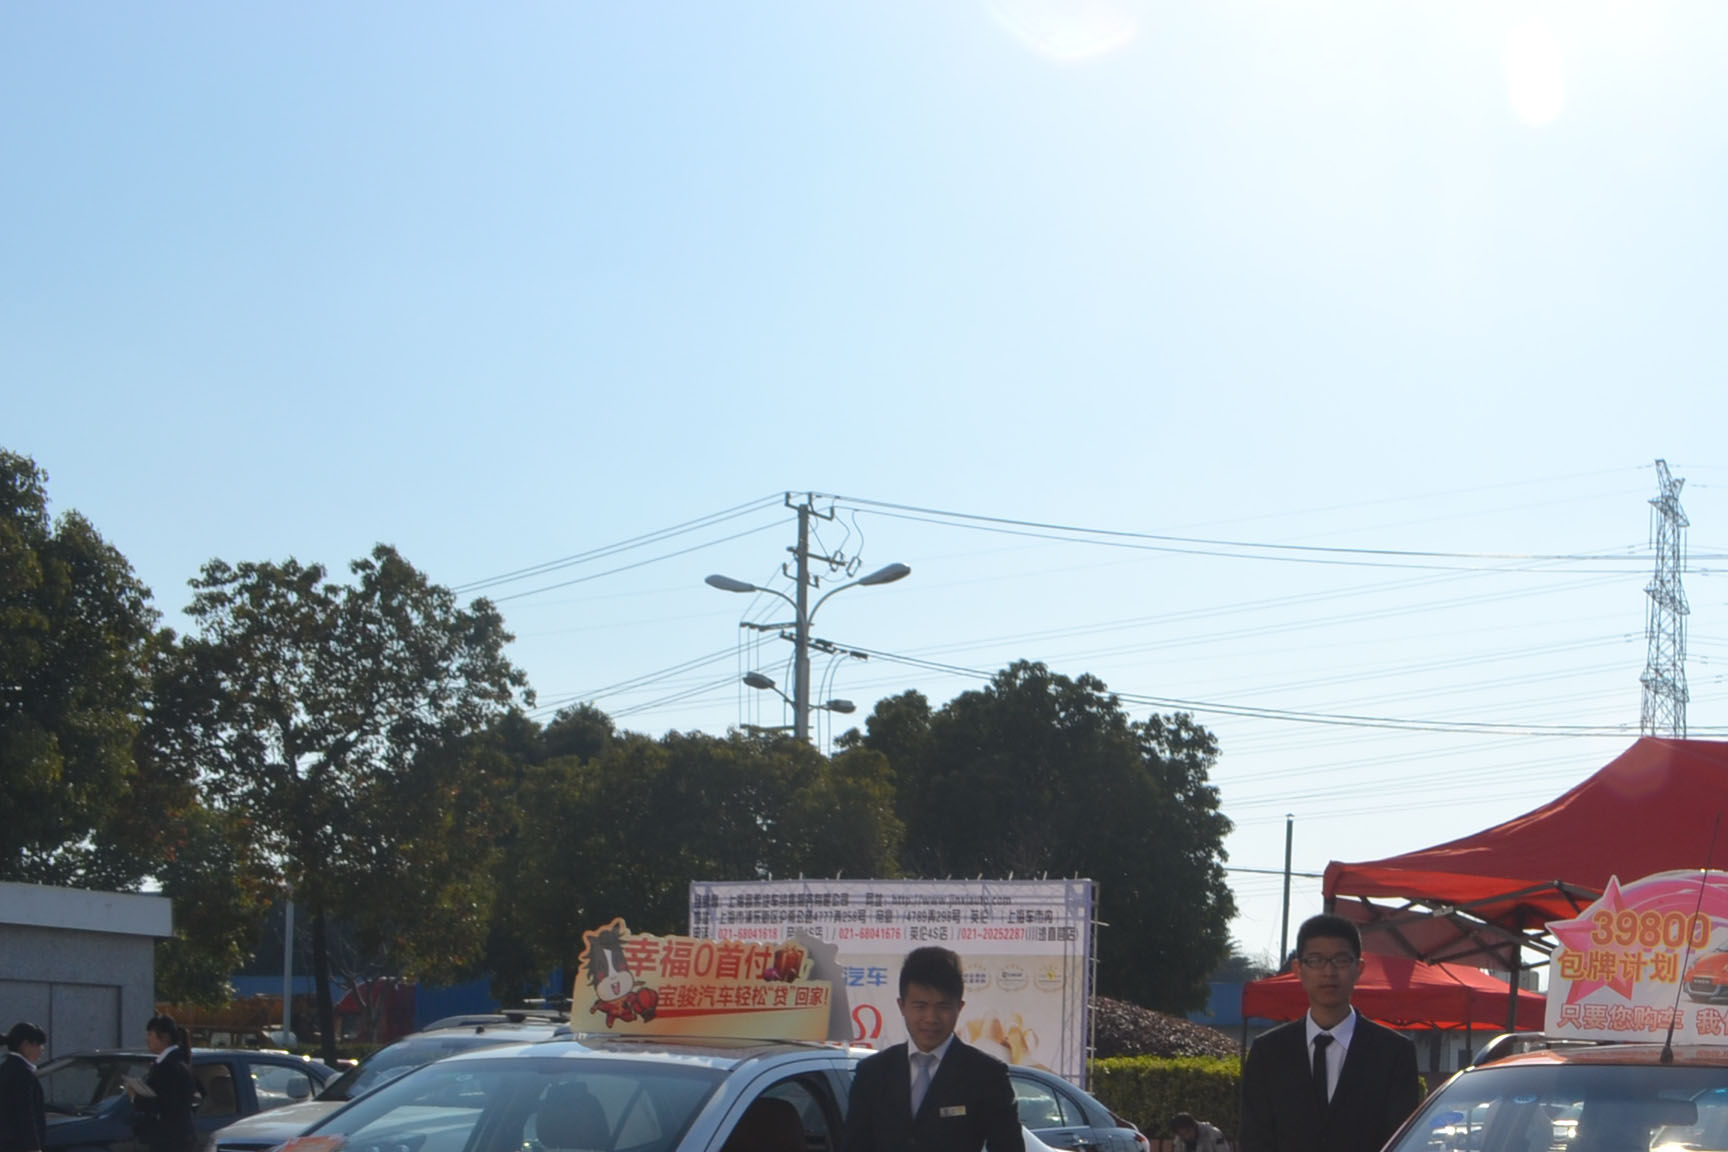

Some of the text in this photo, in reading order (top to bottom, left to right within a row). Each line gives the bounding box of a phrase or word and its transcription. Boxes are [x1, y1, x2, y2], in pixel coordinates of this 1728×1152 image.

[1591, 909, 1712, 950] 39800
[624, 938, 773, 980] 幸福0首付
[843, 966, 888, 987] 汽车
[1558, 949, 1681, 984] 包牌计划
[1557, 1002, 1684, 1032] 只要您购车
